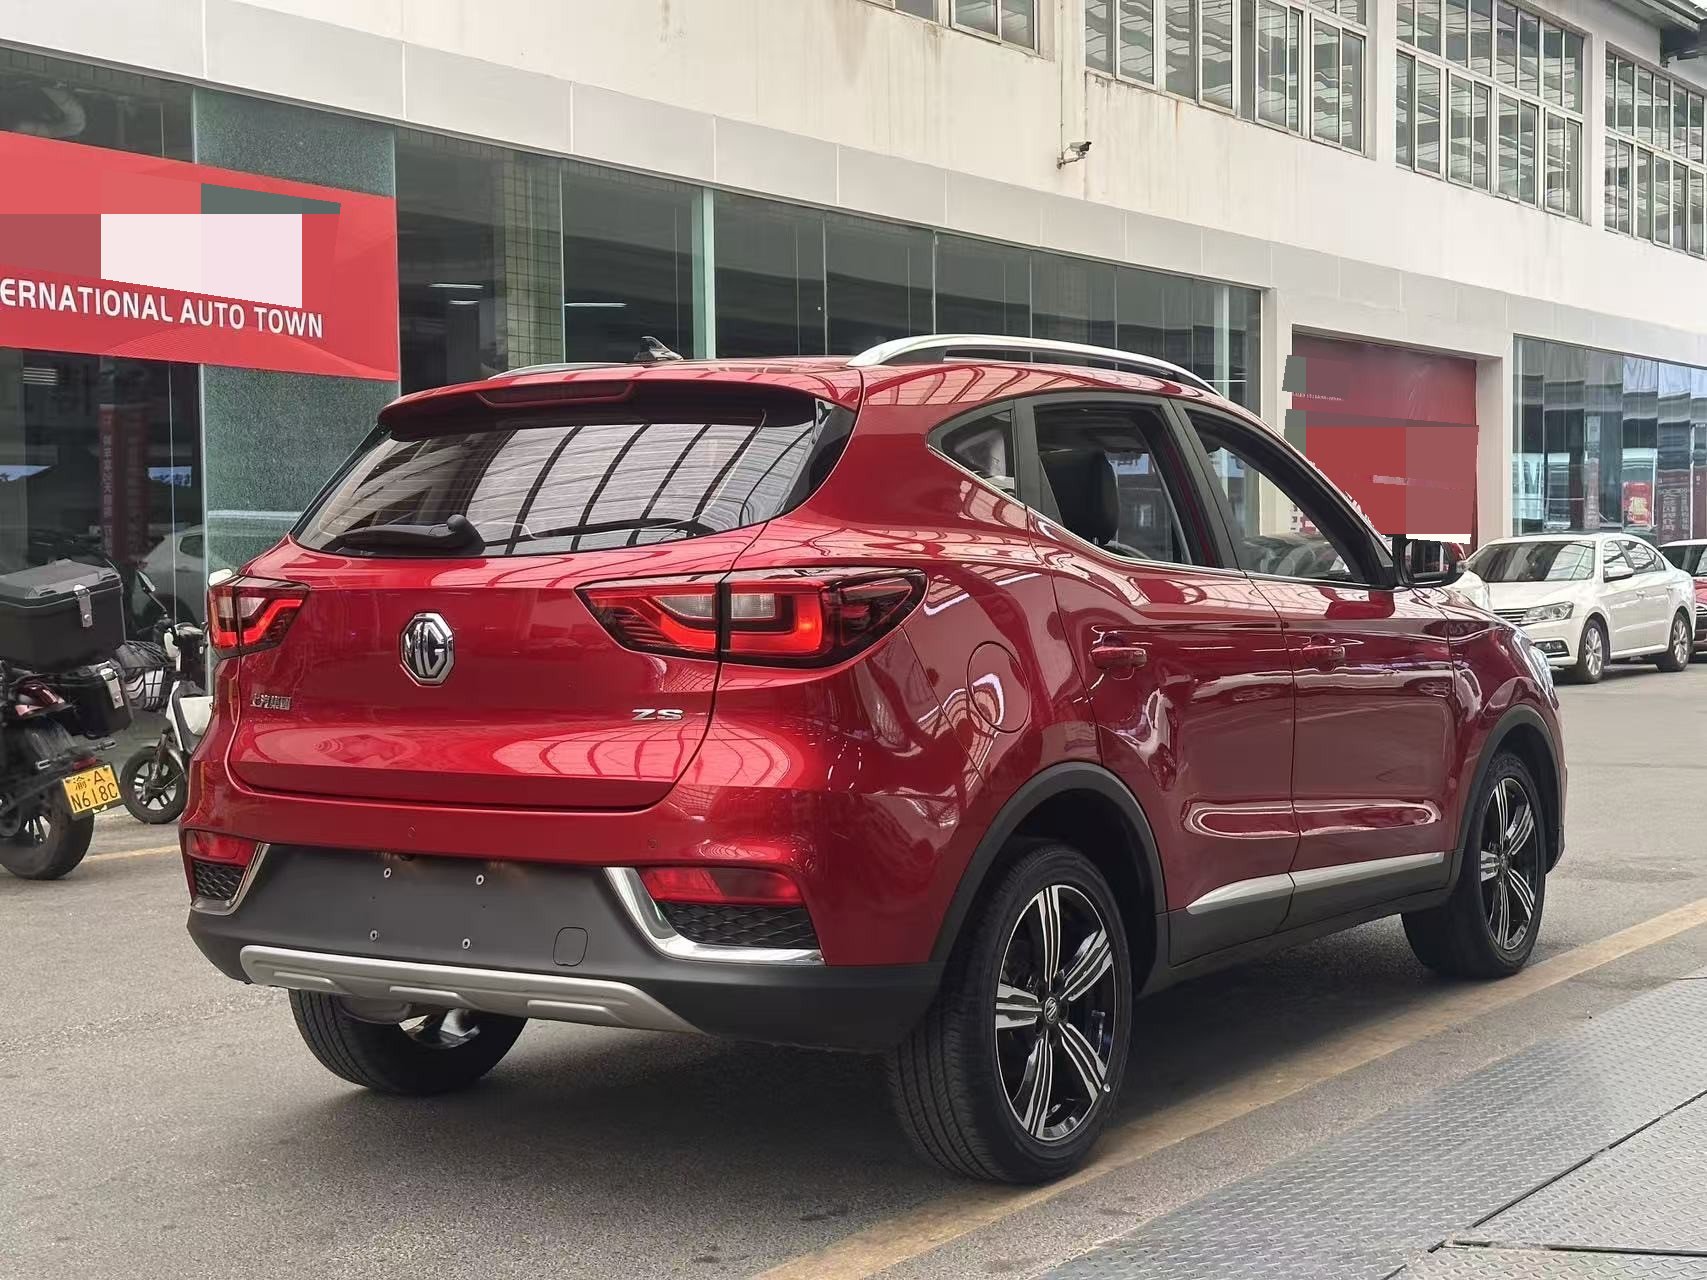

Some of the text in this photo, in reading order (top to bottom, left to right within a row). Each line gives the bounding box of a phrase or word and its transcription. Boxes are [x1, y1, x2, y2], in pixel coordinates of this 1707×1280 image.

[0, 278, 323, 339] ERNATIONAL AUTO TOWN
[403, 622, 446, 677] MG
[631, 708, 684, 721] ZS
[70, 782, 118, 811] N618C
